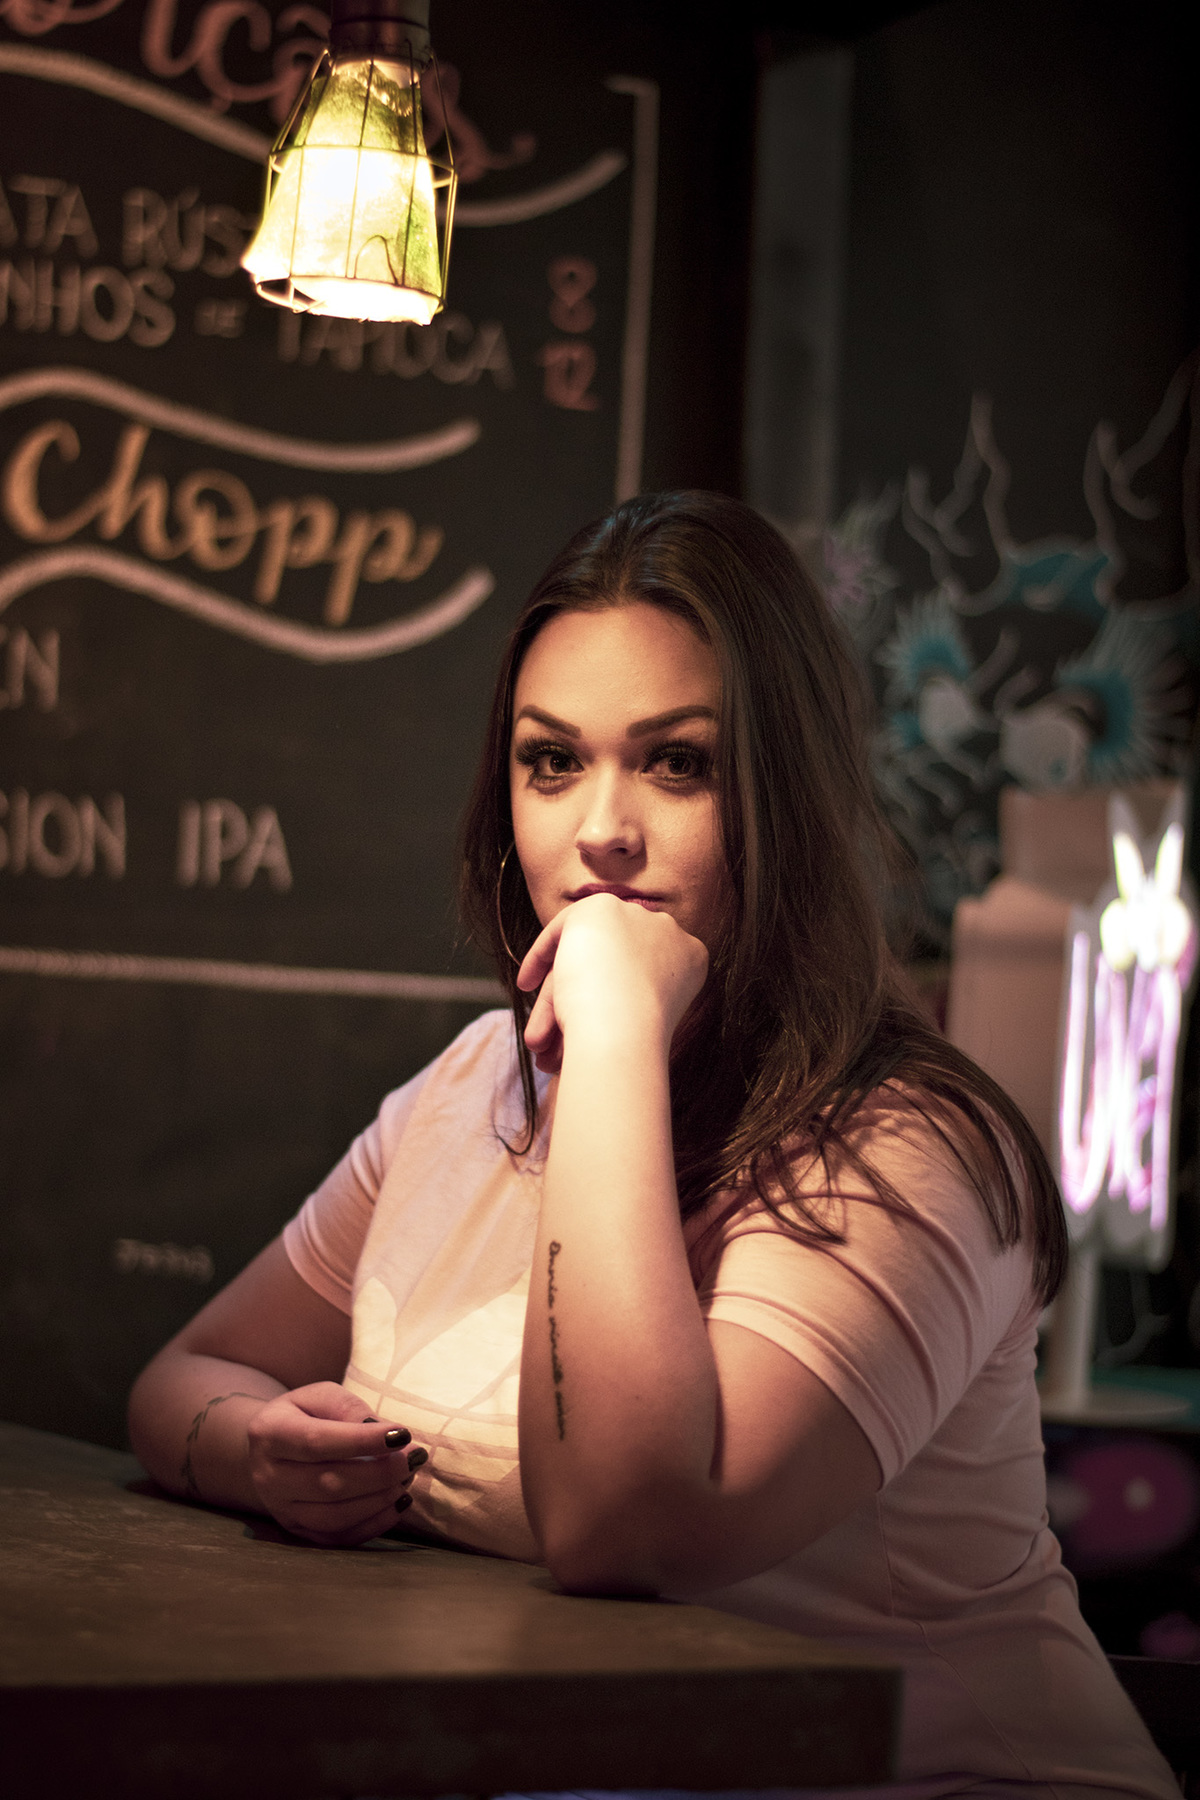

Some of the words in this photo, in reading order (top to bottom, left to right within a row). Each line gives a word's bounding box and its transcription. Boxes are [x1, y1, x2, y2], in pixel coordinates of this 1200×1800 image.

[122, 186, 262, 278] RÚS
[2, 418, 445, 626] Chopp
[176, 797, 294, 894] IPA
